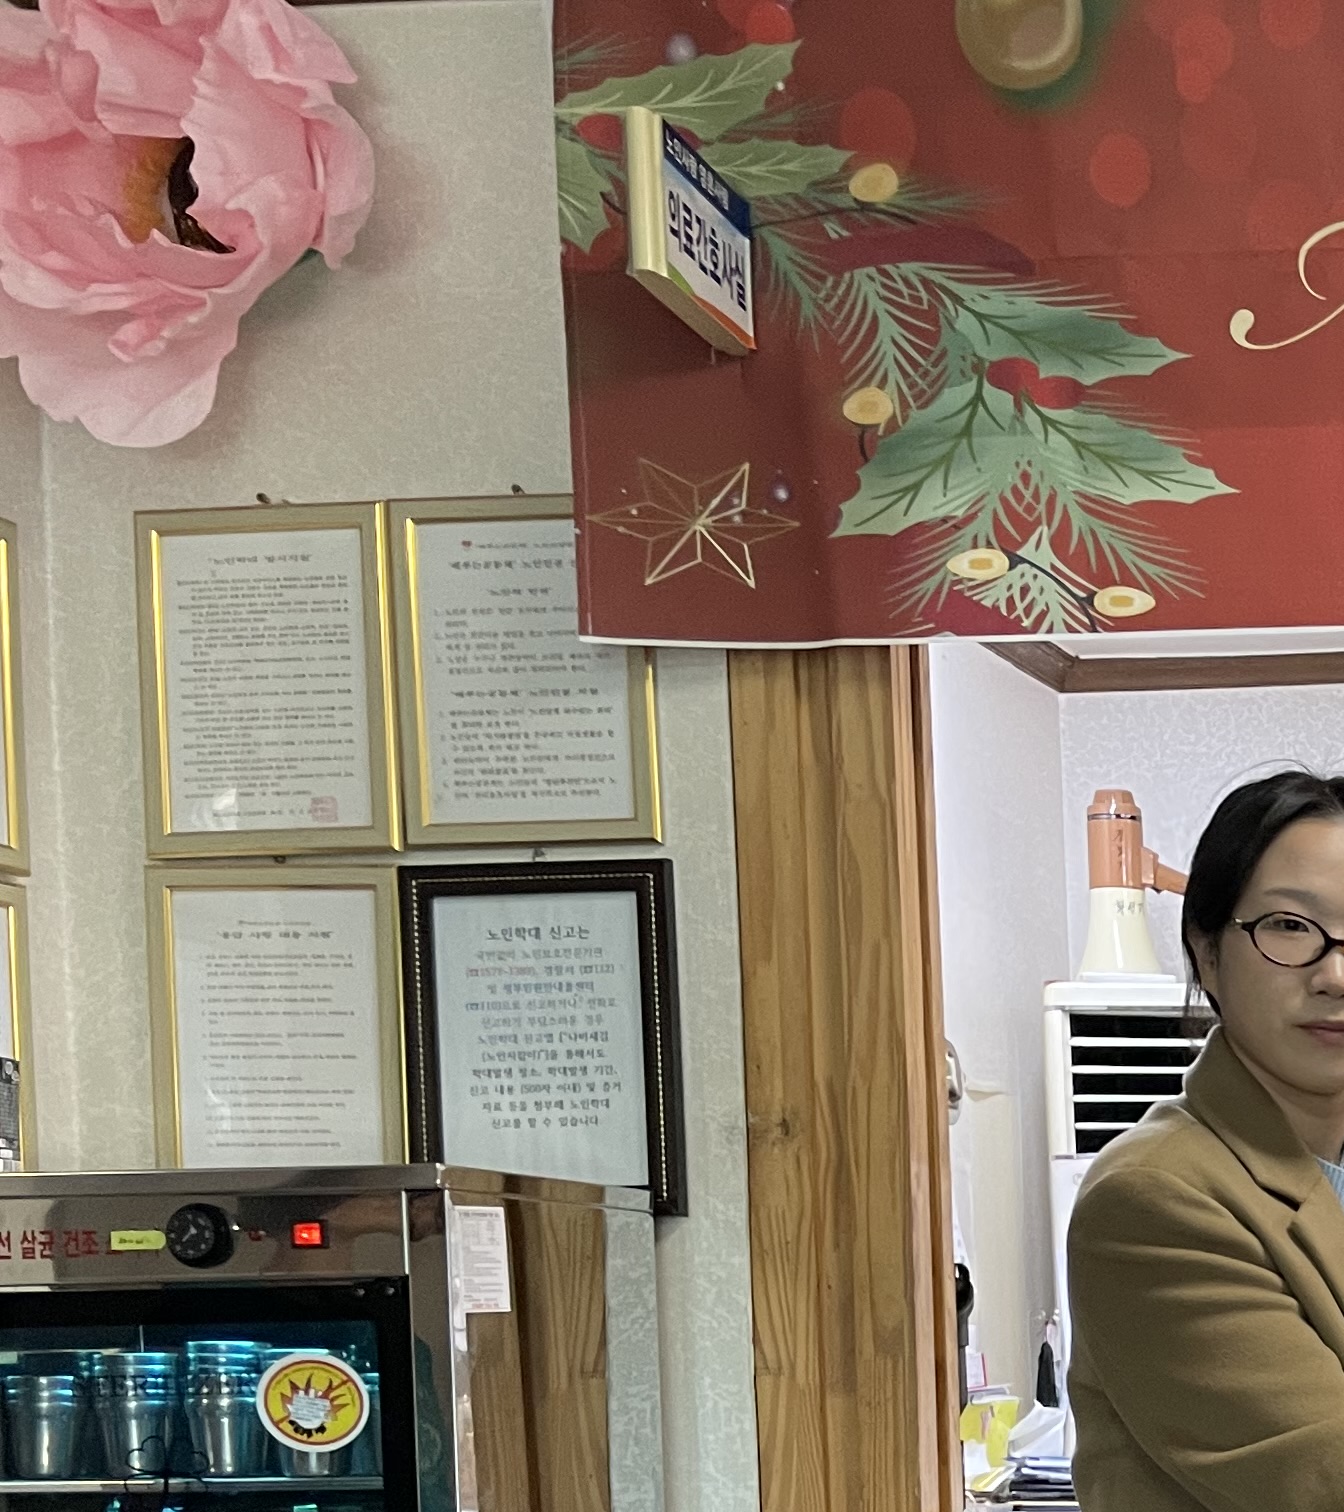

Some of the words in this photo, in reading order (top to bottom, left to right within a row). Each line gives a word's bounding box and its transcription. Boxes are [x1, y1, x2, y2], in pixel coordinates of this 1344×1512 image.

[487, 926, 541, 941] 노인학대
[549, 925, 590, 940] 신고는
[20, 1229, 55, 1260] 살균
[63, 1228, 98, 1259] 건조
